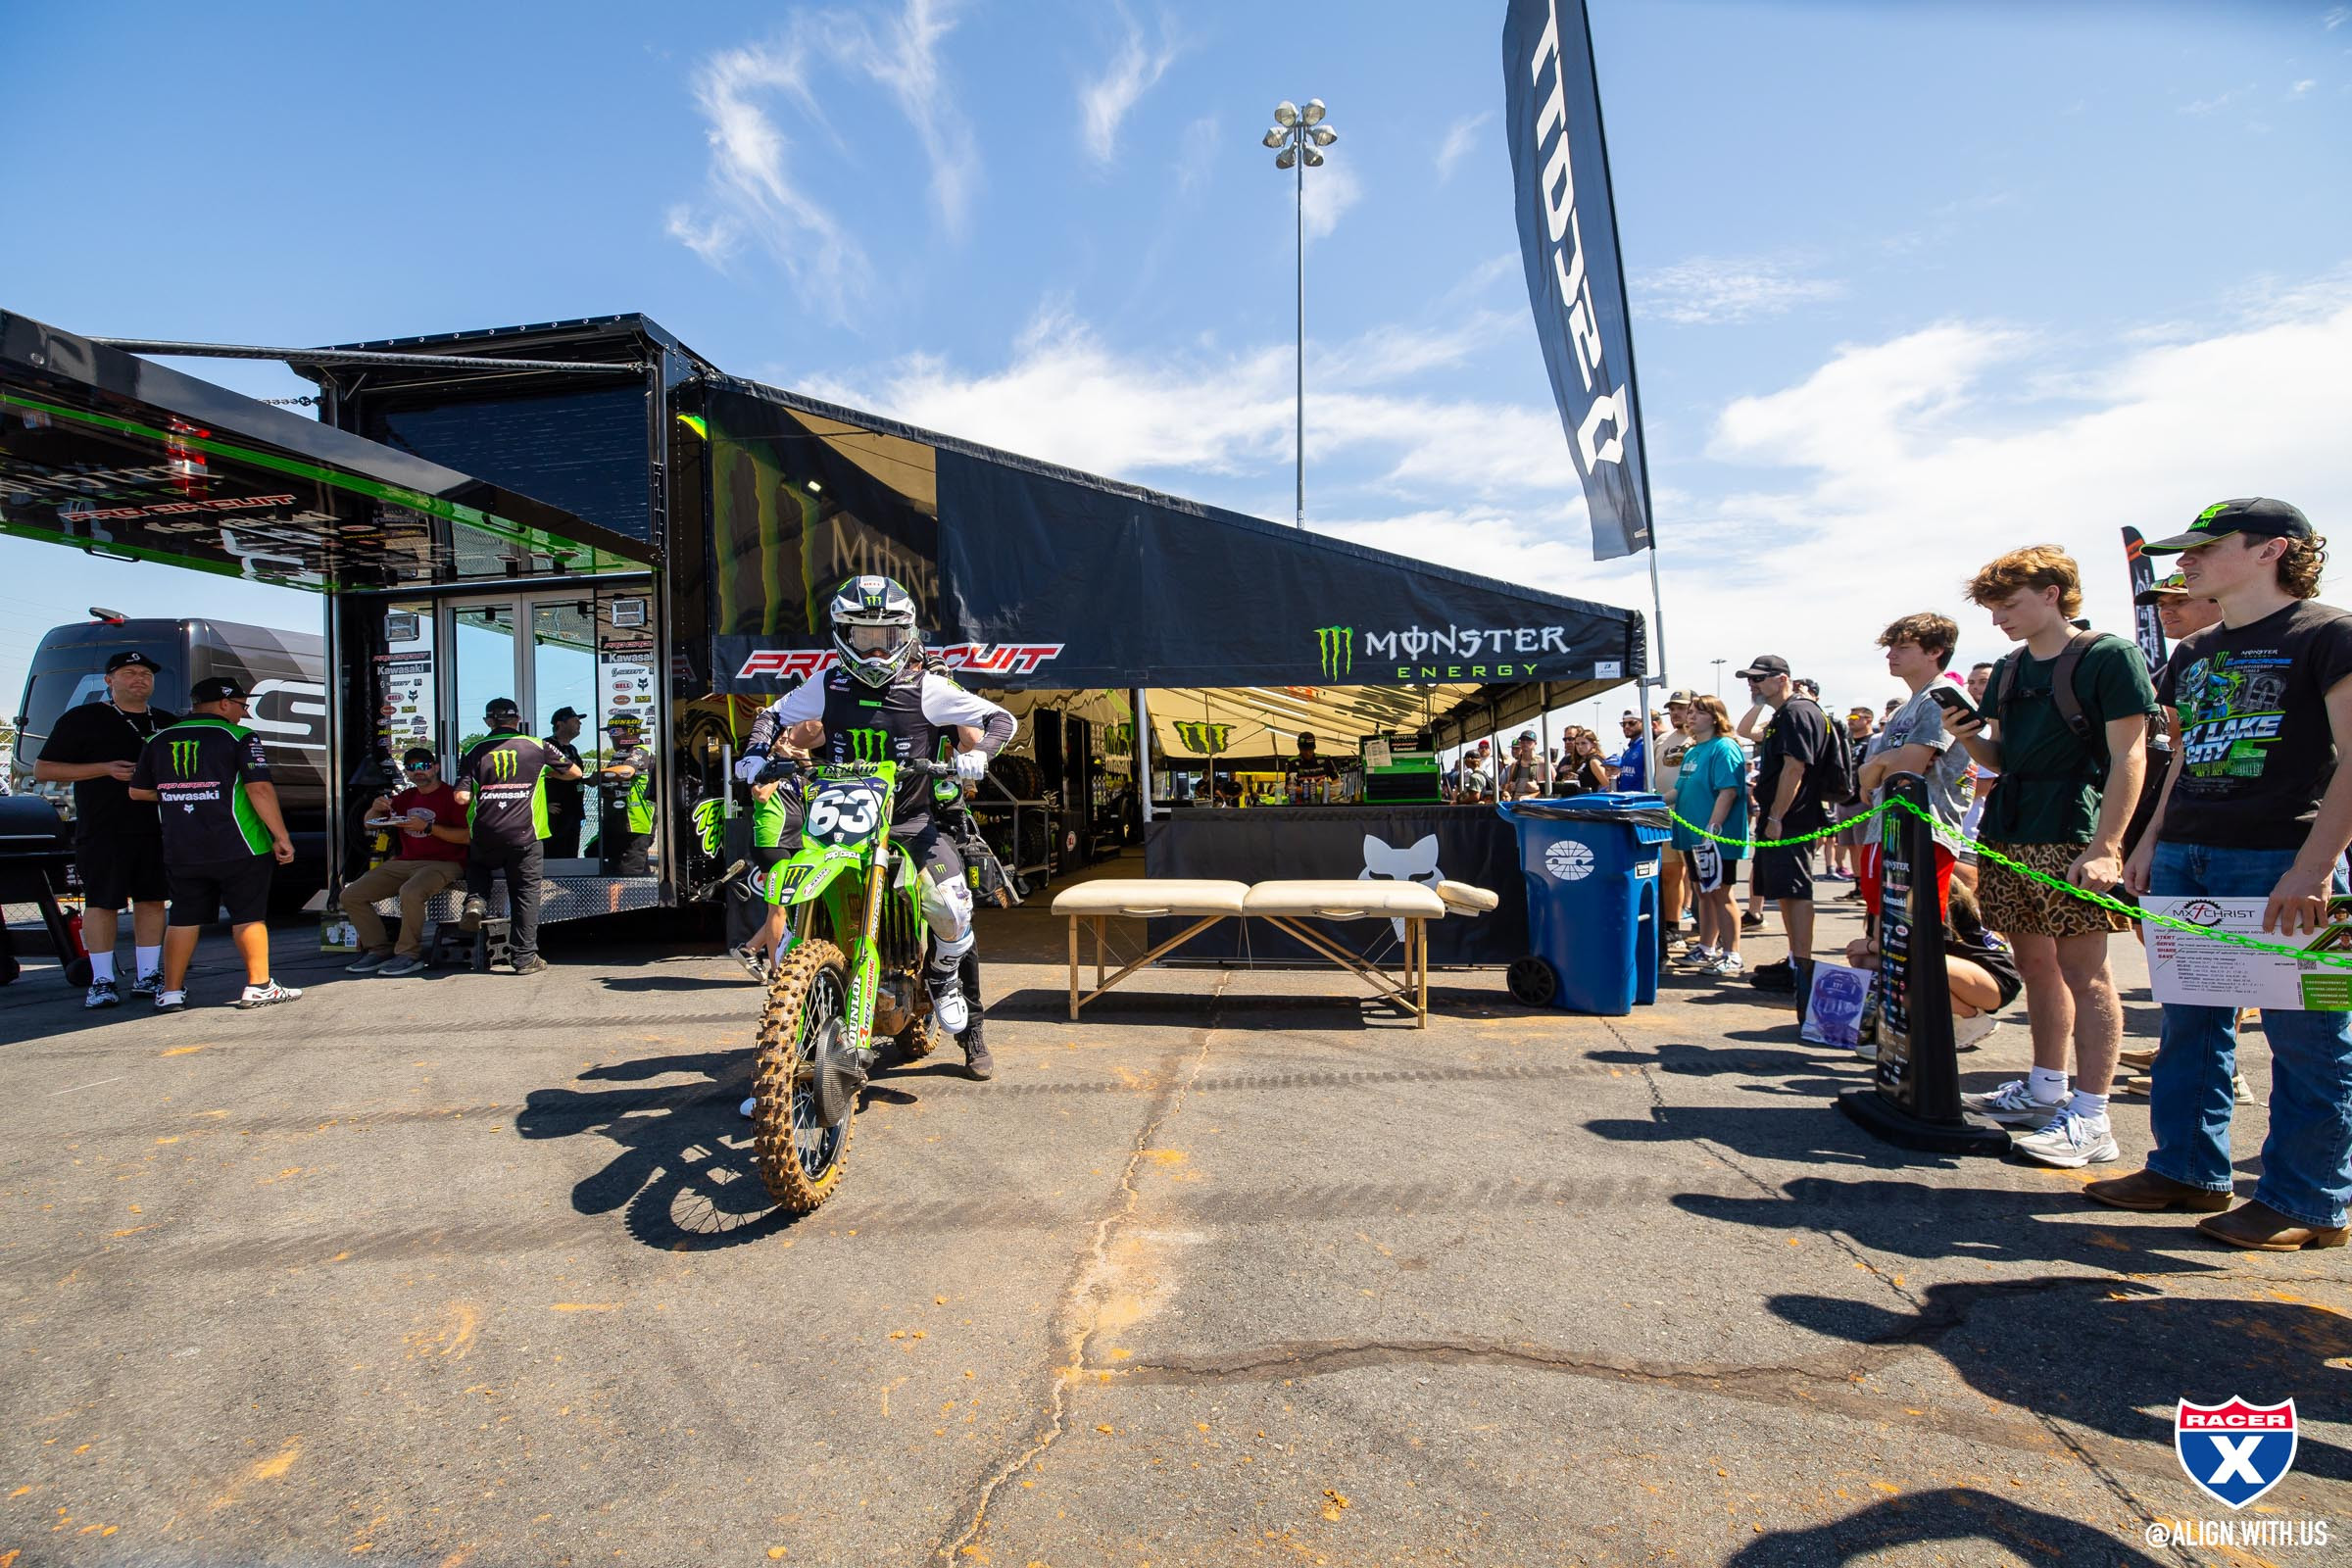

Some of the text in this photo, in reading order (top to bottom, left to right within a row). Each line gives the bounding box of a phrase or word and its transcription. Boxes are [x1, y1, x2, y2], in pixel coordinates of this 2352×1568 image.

[59, 495, 297, 521] PRO CIRCUIT
[1364, 624, 1571, 662] MONSTER
[377, 663, 424, 675] Kawasaki
[1397, 663, 1538, 679] ENERGY
[2204, 714, 2283, 742] LAKE
[2185, 740, 2232, 765] CITY
[162, 790, 220, 802] Kawasaki
[480, 790, 531, 800] Kawasaki
[808, 789, 883, 836] 63
[870, 875, 884, 941] PRO CIRCUIT
[866, 958, 875, 1000] BRAKING
